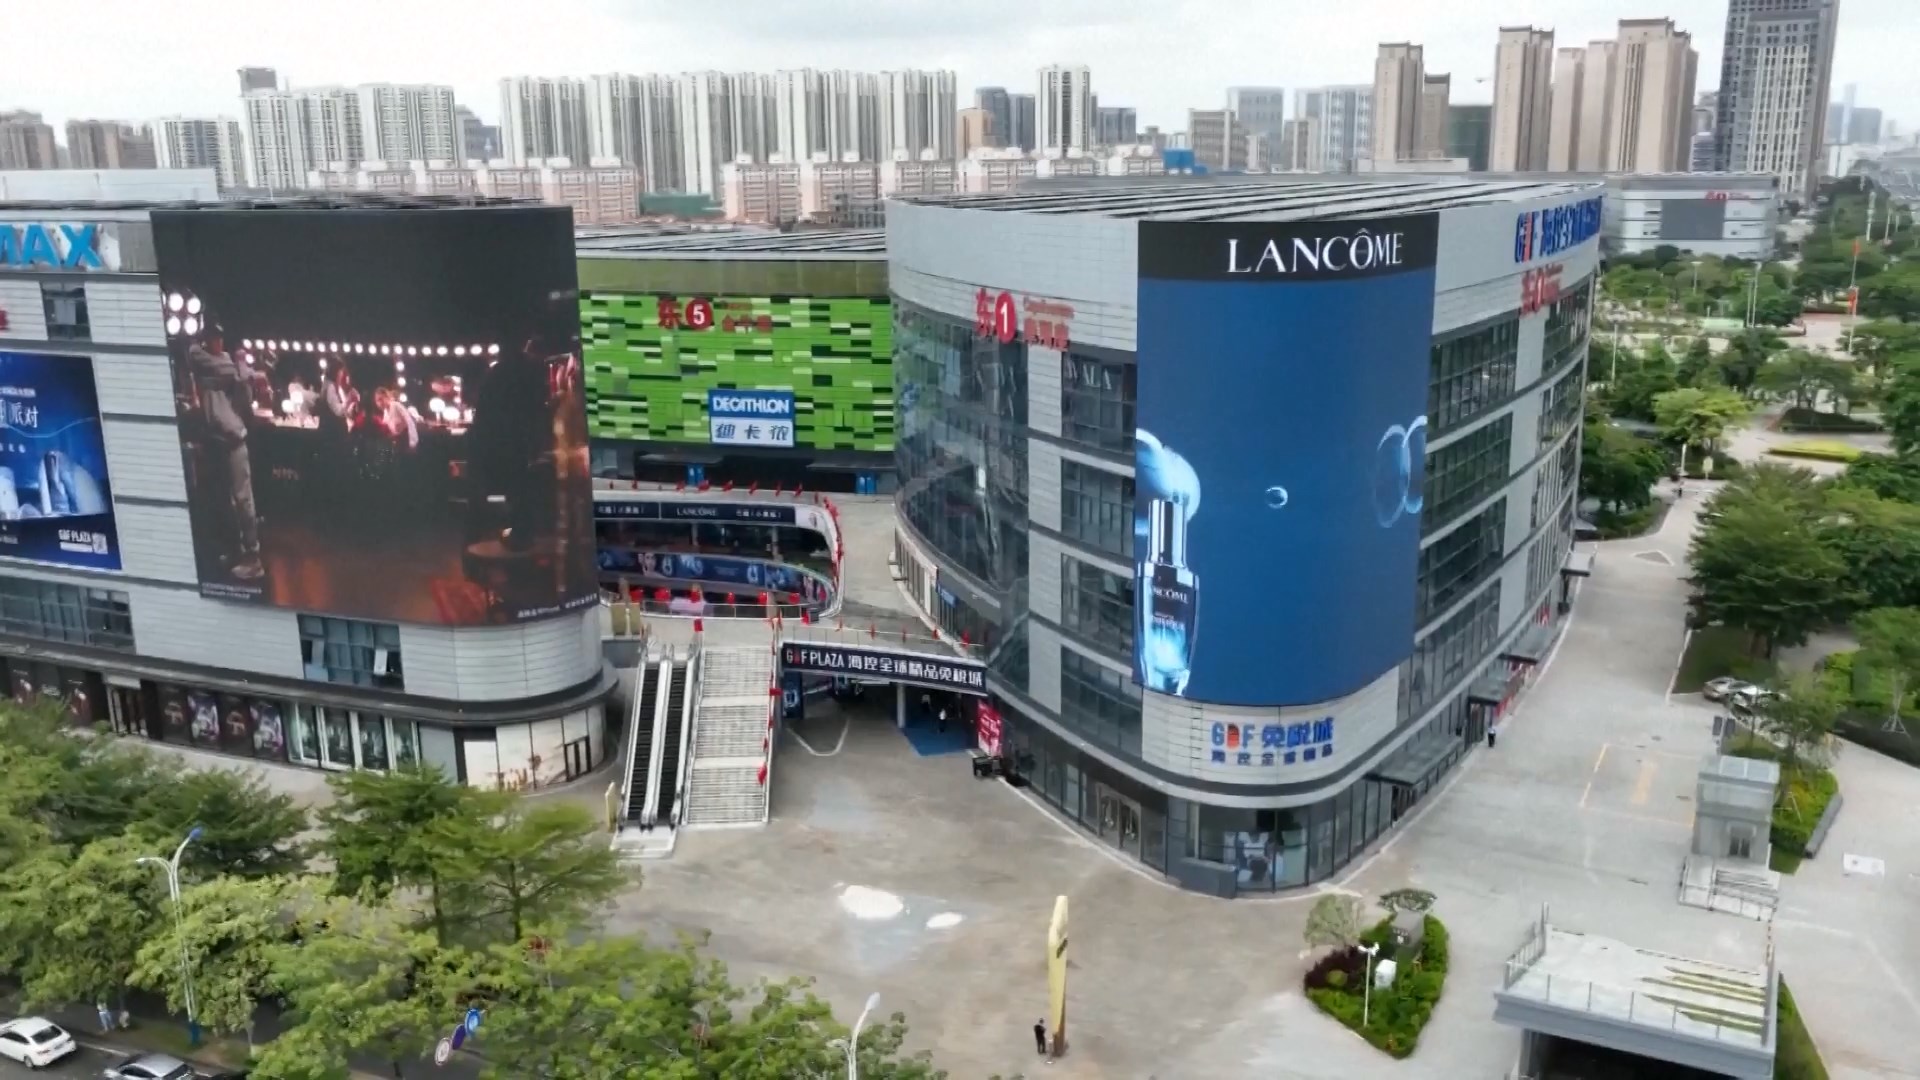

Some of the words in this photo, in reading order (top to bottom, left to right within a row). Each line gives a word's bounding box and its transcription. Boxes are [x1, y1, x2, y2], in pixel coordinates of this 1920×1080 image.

[1228, 228, 1404, 273] LANCÔME
[713, 397, 790, 414] DECATHLON
[810, 651, 845, 669] PLAZA
